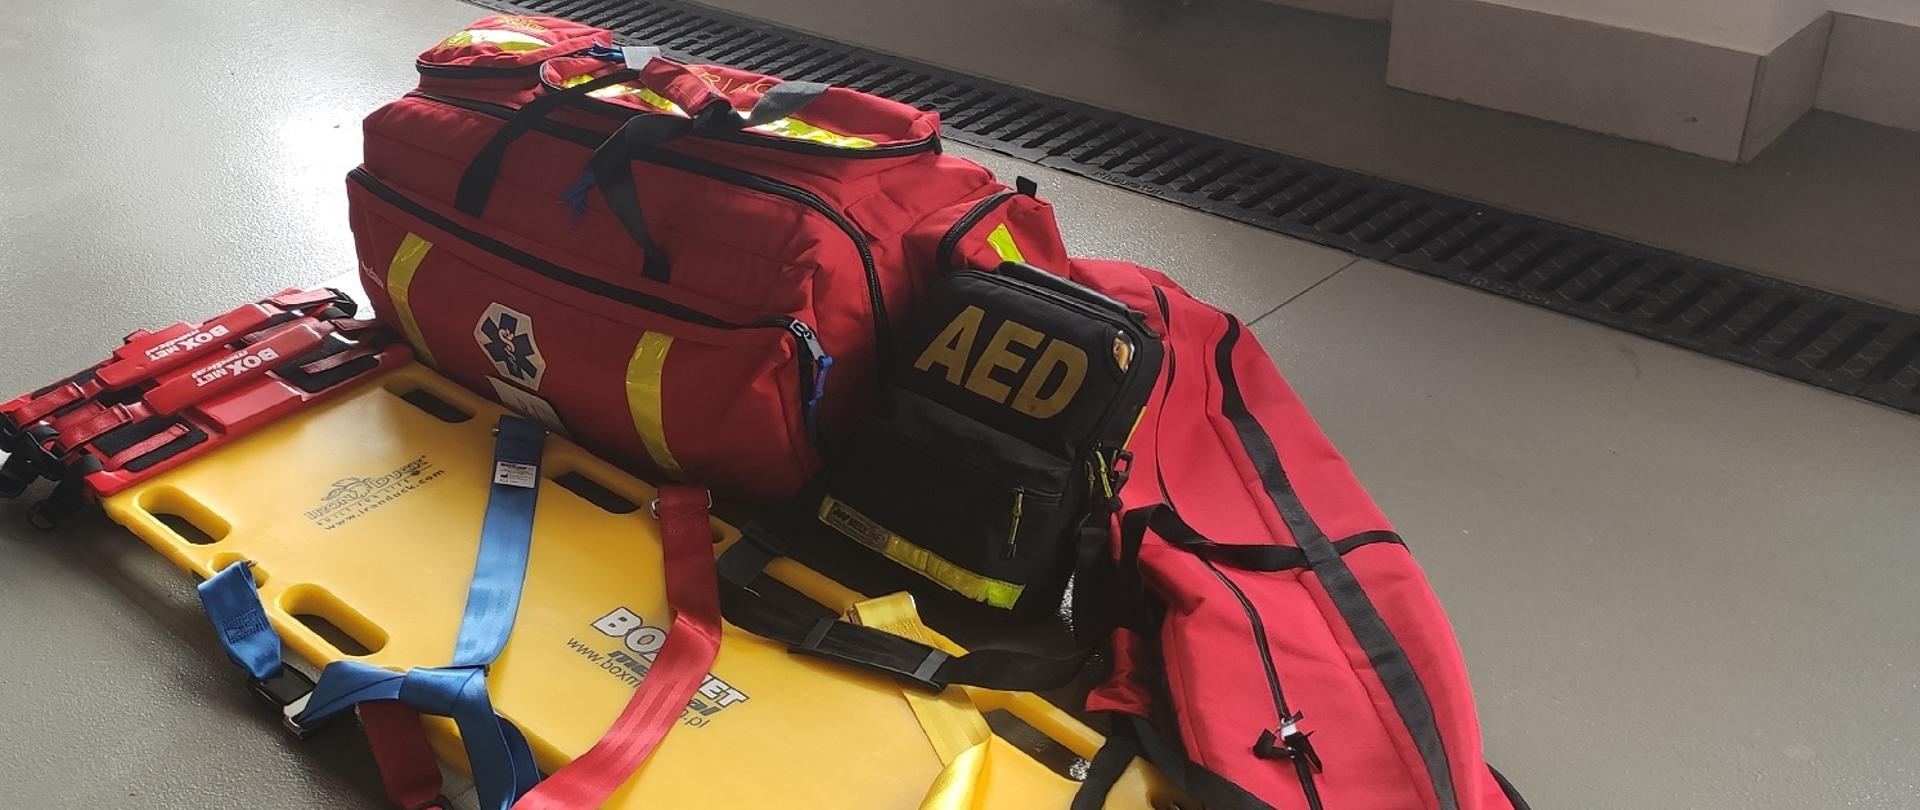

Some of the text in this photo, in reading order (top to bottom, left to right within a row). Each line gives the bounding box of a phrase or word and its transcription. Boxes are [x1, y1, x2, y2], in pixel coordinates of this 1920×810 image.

[149, 324, 229, 361] BOX MET
[191, 350, 248, 379] medical
[196, 347, 279, 387] BOX MET
[914, 304, 1089, 419] AED
[325, 468, 446, 530] www.ironduck.com
[590, 606, 750, 709] BO ET
